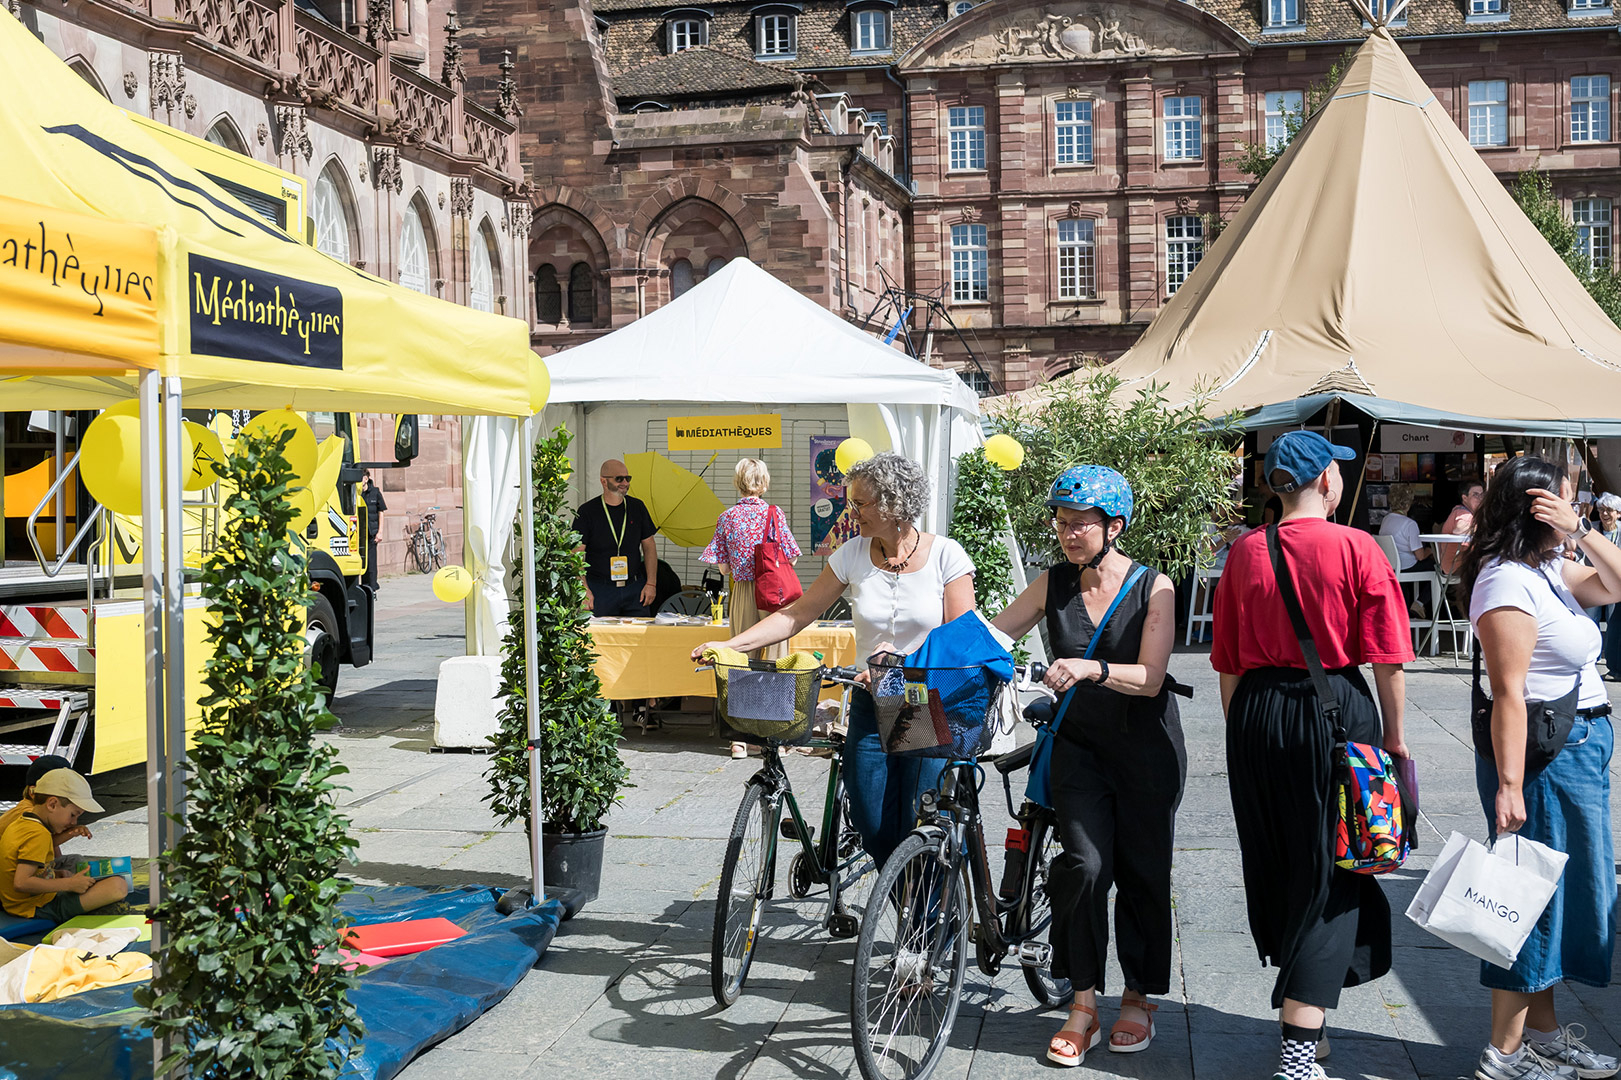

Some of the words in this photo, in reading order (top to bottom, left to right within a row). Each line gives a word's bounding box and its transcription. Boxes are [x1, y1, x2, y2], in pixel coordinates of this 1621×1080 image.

[193, 271, 340, 355] Médiathèques
[686, 426, 772, 438] MÉDIATHÈQUES
[1402, 433, 1430, 442] Chant
[1464, 887, 1520, 923] MANGO
